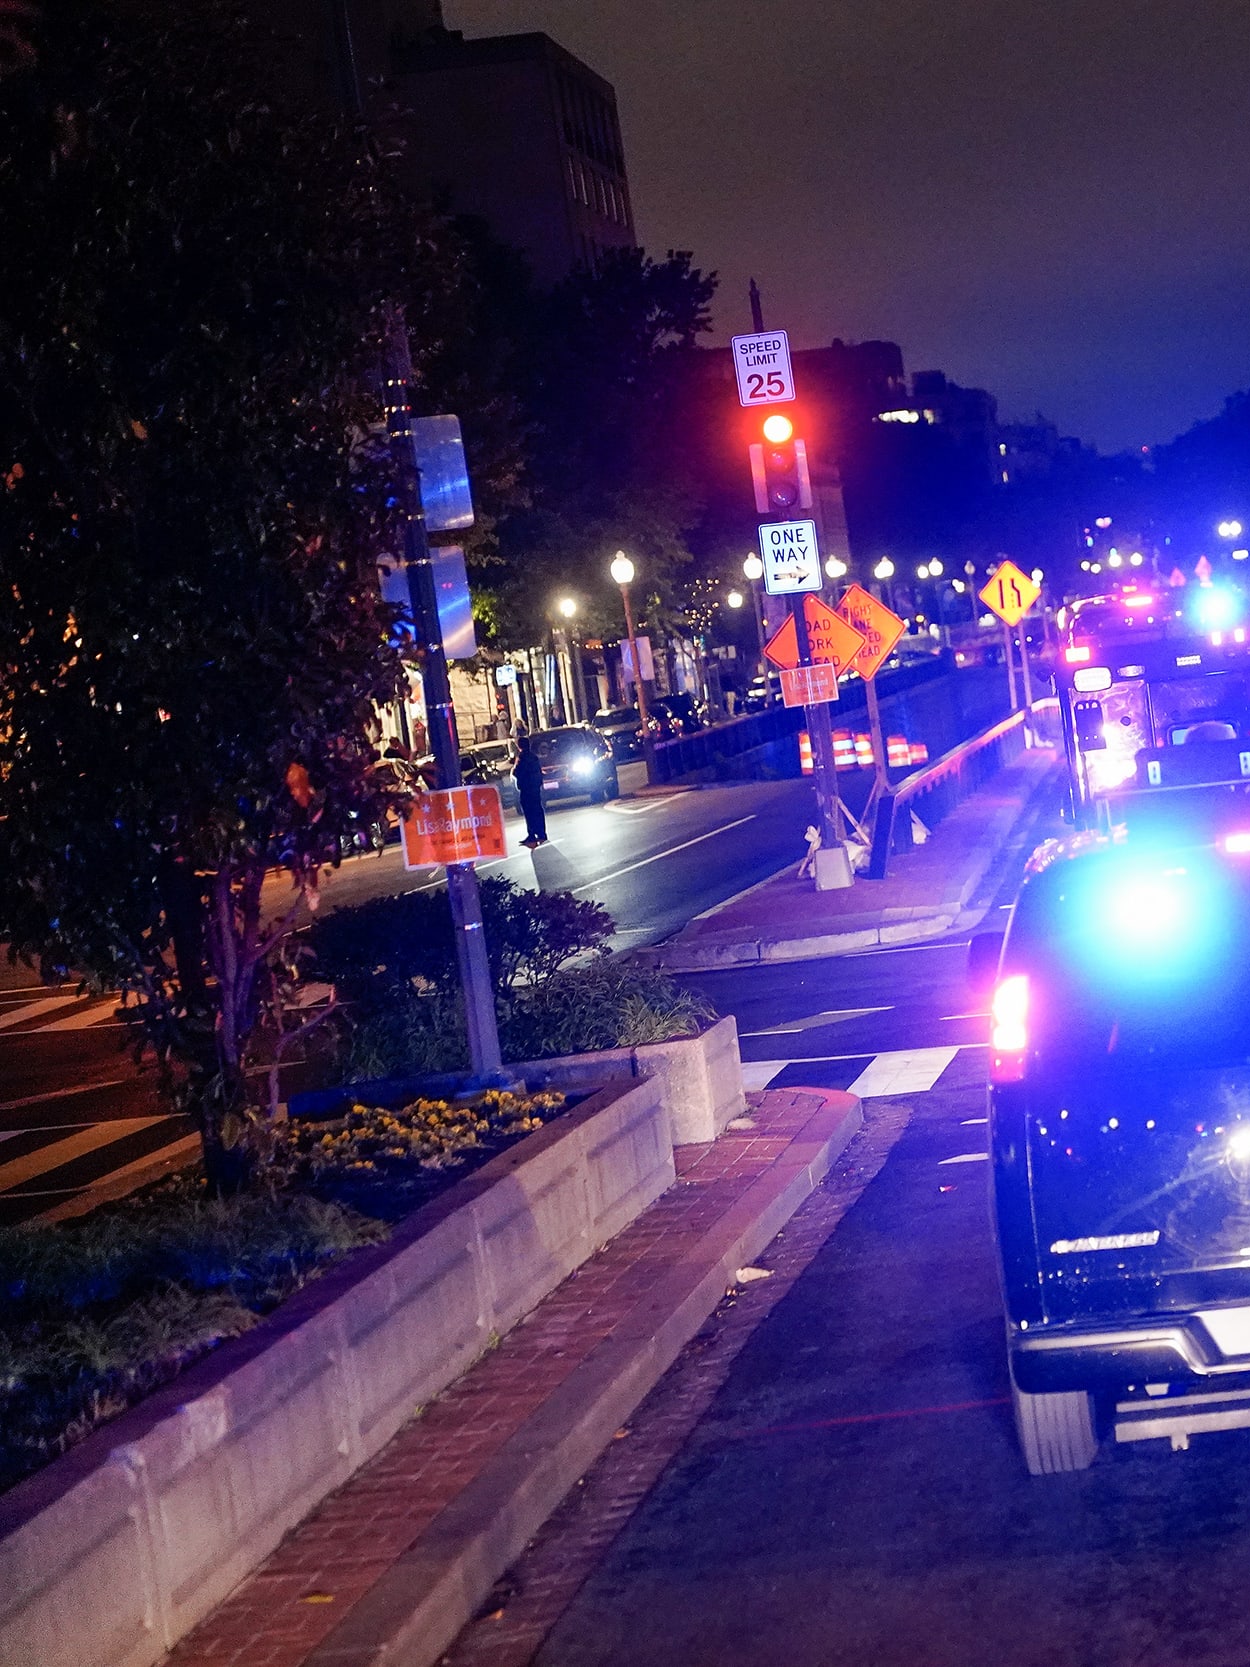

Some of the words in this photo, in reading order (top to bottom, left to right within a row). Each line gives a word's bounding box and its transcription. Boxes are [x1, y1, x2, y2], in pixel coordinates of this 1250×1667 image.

[740, 340, 781, 354] SPEED
[746, 353, 777, 367] LIMIT
[747, 371, 785, 399] 25
[771, 528, 805, 545] ONE
[772, 546, 808, 563] WAY
[806, 619, 831, 632] OAD
[853, 618, 872, 631] ANE
[809, 637, 834, 651] ORK
